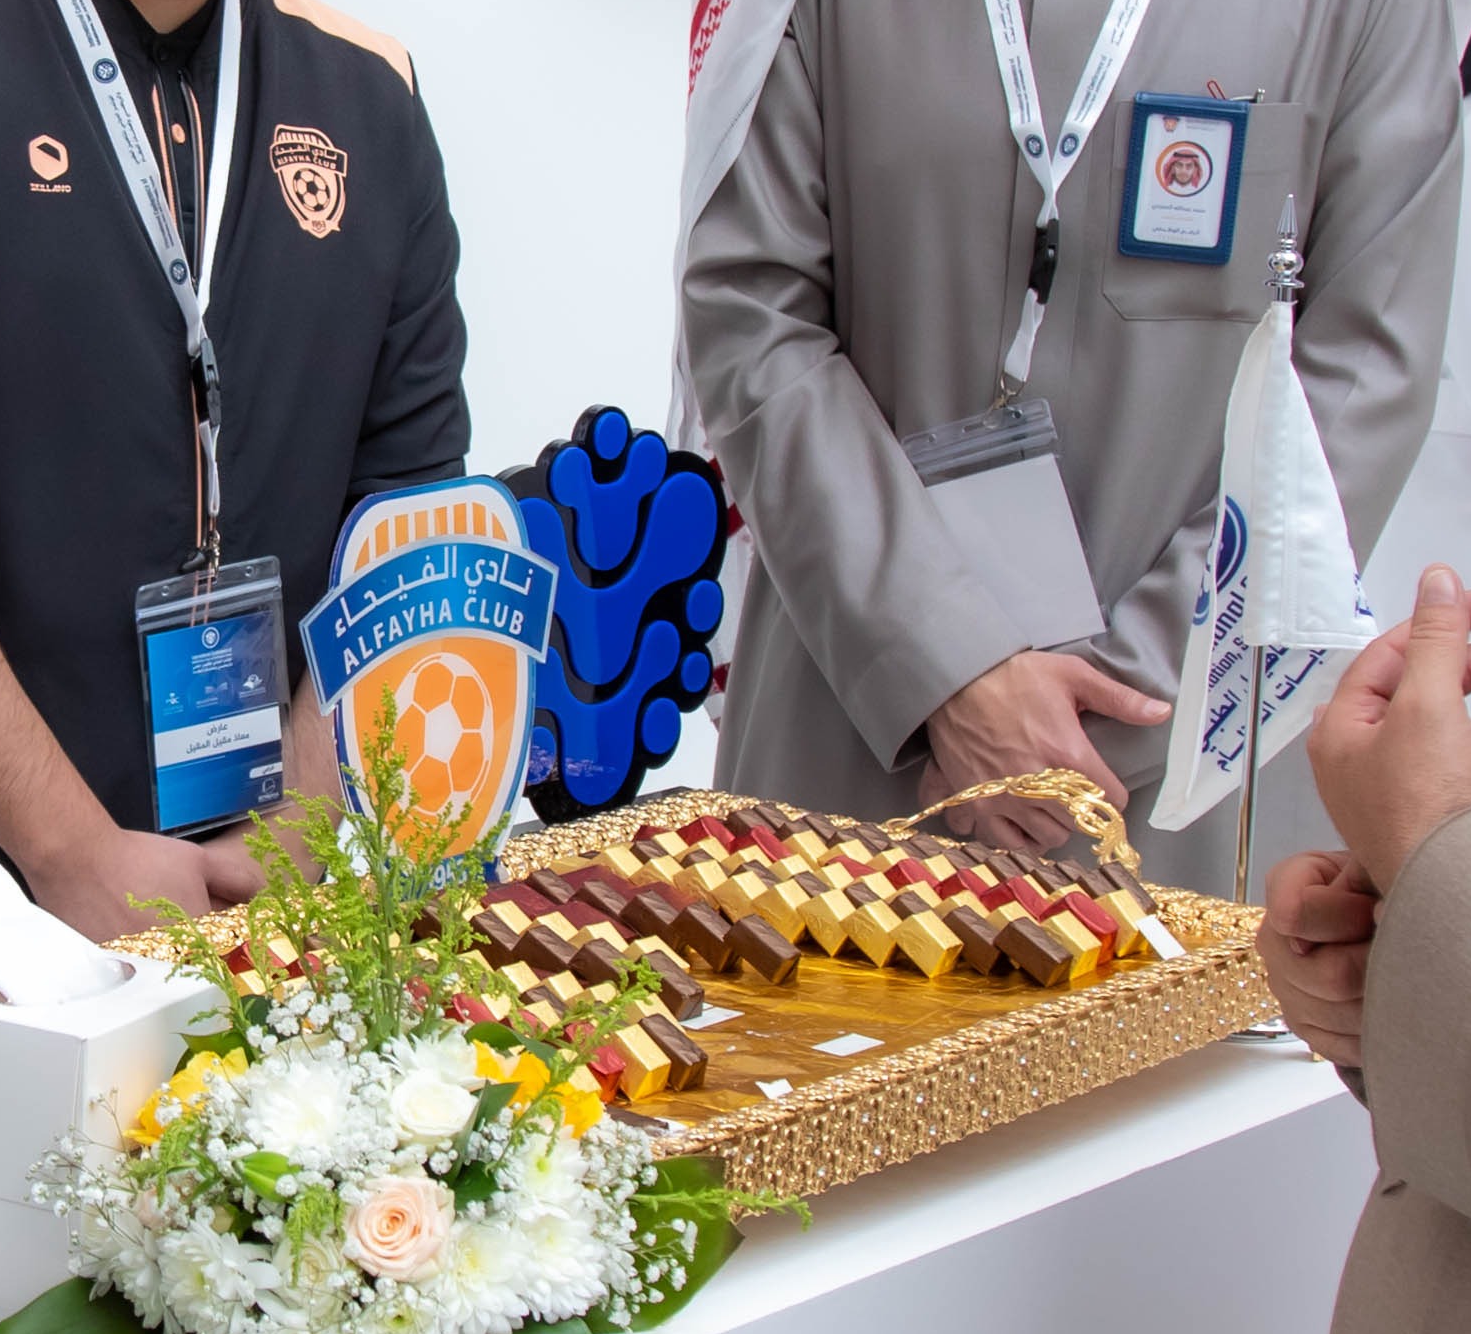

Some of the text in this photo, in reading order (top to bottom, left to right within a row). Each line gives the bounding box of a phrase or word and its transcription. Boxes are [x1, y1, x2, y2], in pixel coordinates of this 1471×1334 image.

[335, 545, 534, 639] نادي الفيحاء
[343, 596, 525, 675] ALFAYHA CLUB
